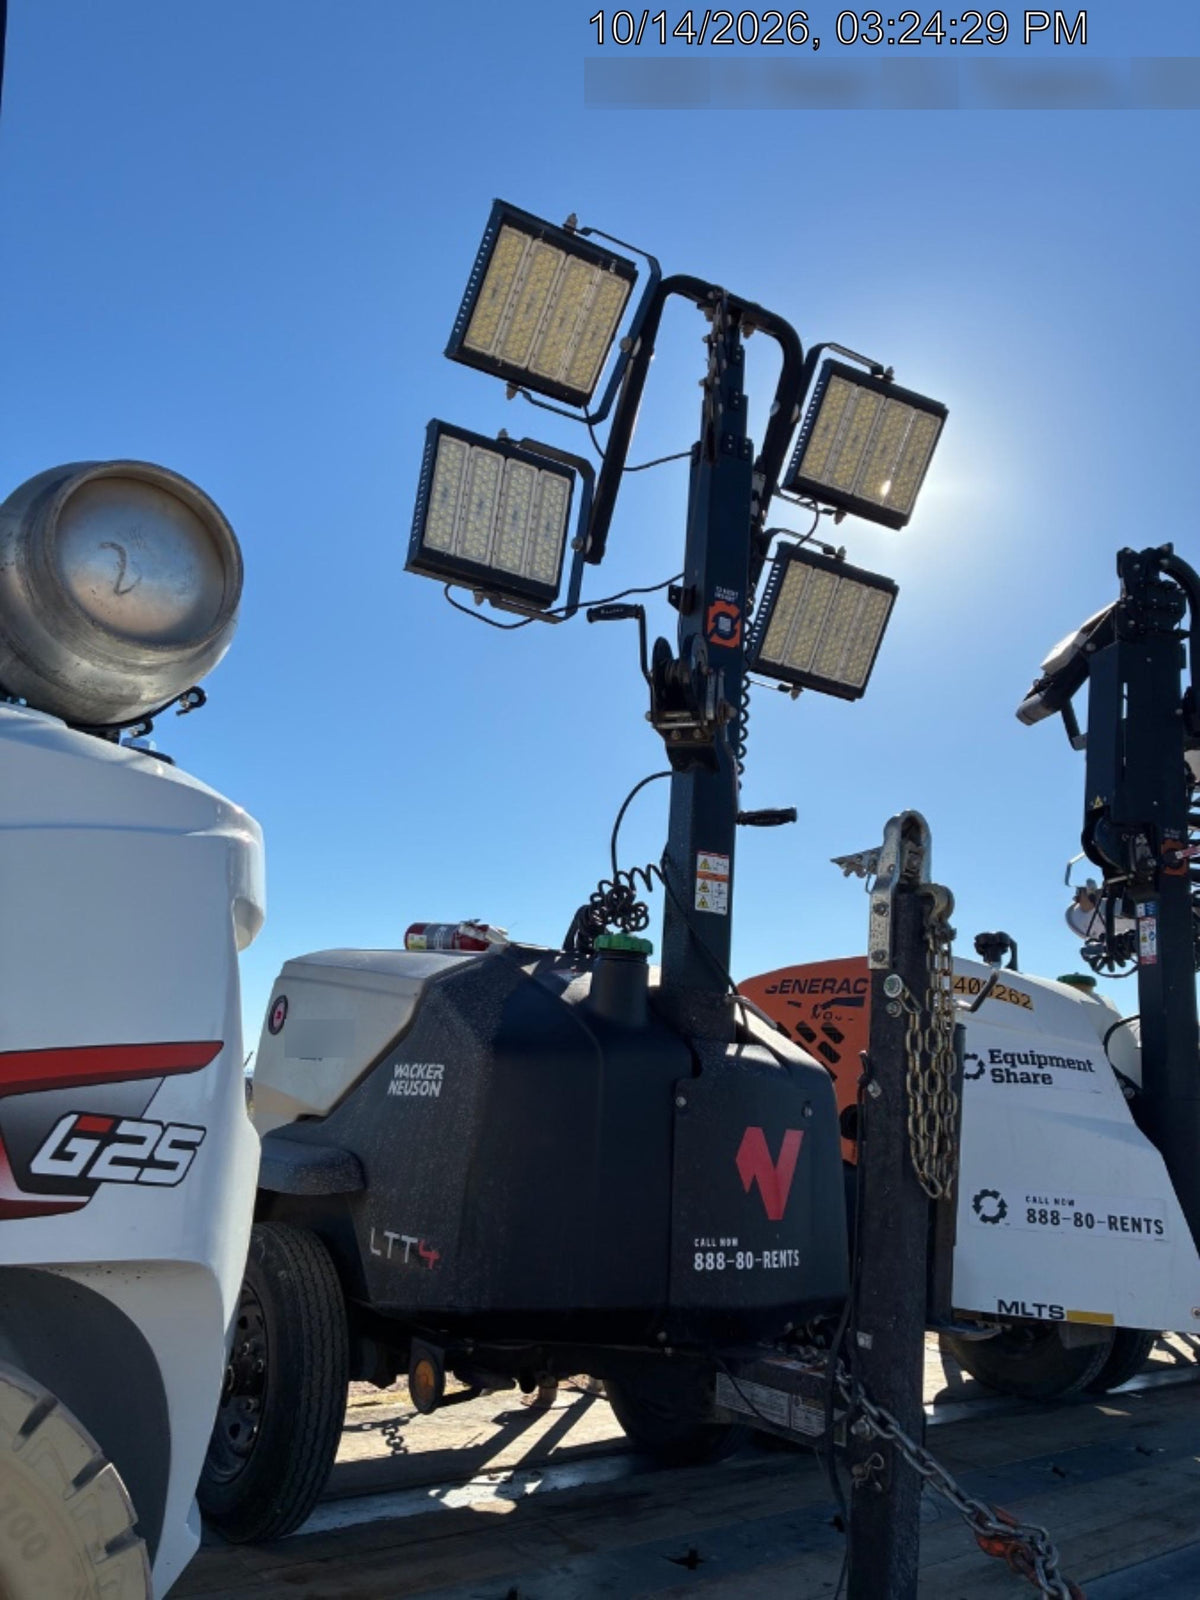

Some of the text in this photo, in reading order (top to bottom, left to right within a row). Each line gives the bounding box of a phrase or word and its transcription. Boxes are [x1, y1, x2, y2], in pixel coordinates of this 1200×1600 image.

[953, 975, 1034, 1011] 40262
[394, 1063, 446, 1080] WACKER
[988, 1048, 1096, 1074] Equipment
[990, 1067, 1053, 1085] Share
[387, 1080, 442, 1098] NEUSON
[30, 1111, 207, 1188] G25
[1025, 1195, 1076, 1208] CALL NOW
[1026, 1207, 1165, 1236] 888-80-RENTS
[370, 1226, 441, 1271] LTT4
[694, 1237, 739, 1248] CALL NOW
[694, 1249, 800, 1271] 888-80-RENTS
[997, 1299, 1065, 1321] MLTS
